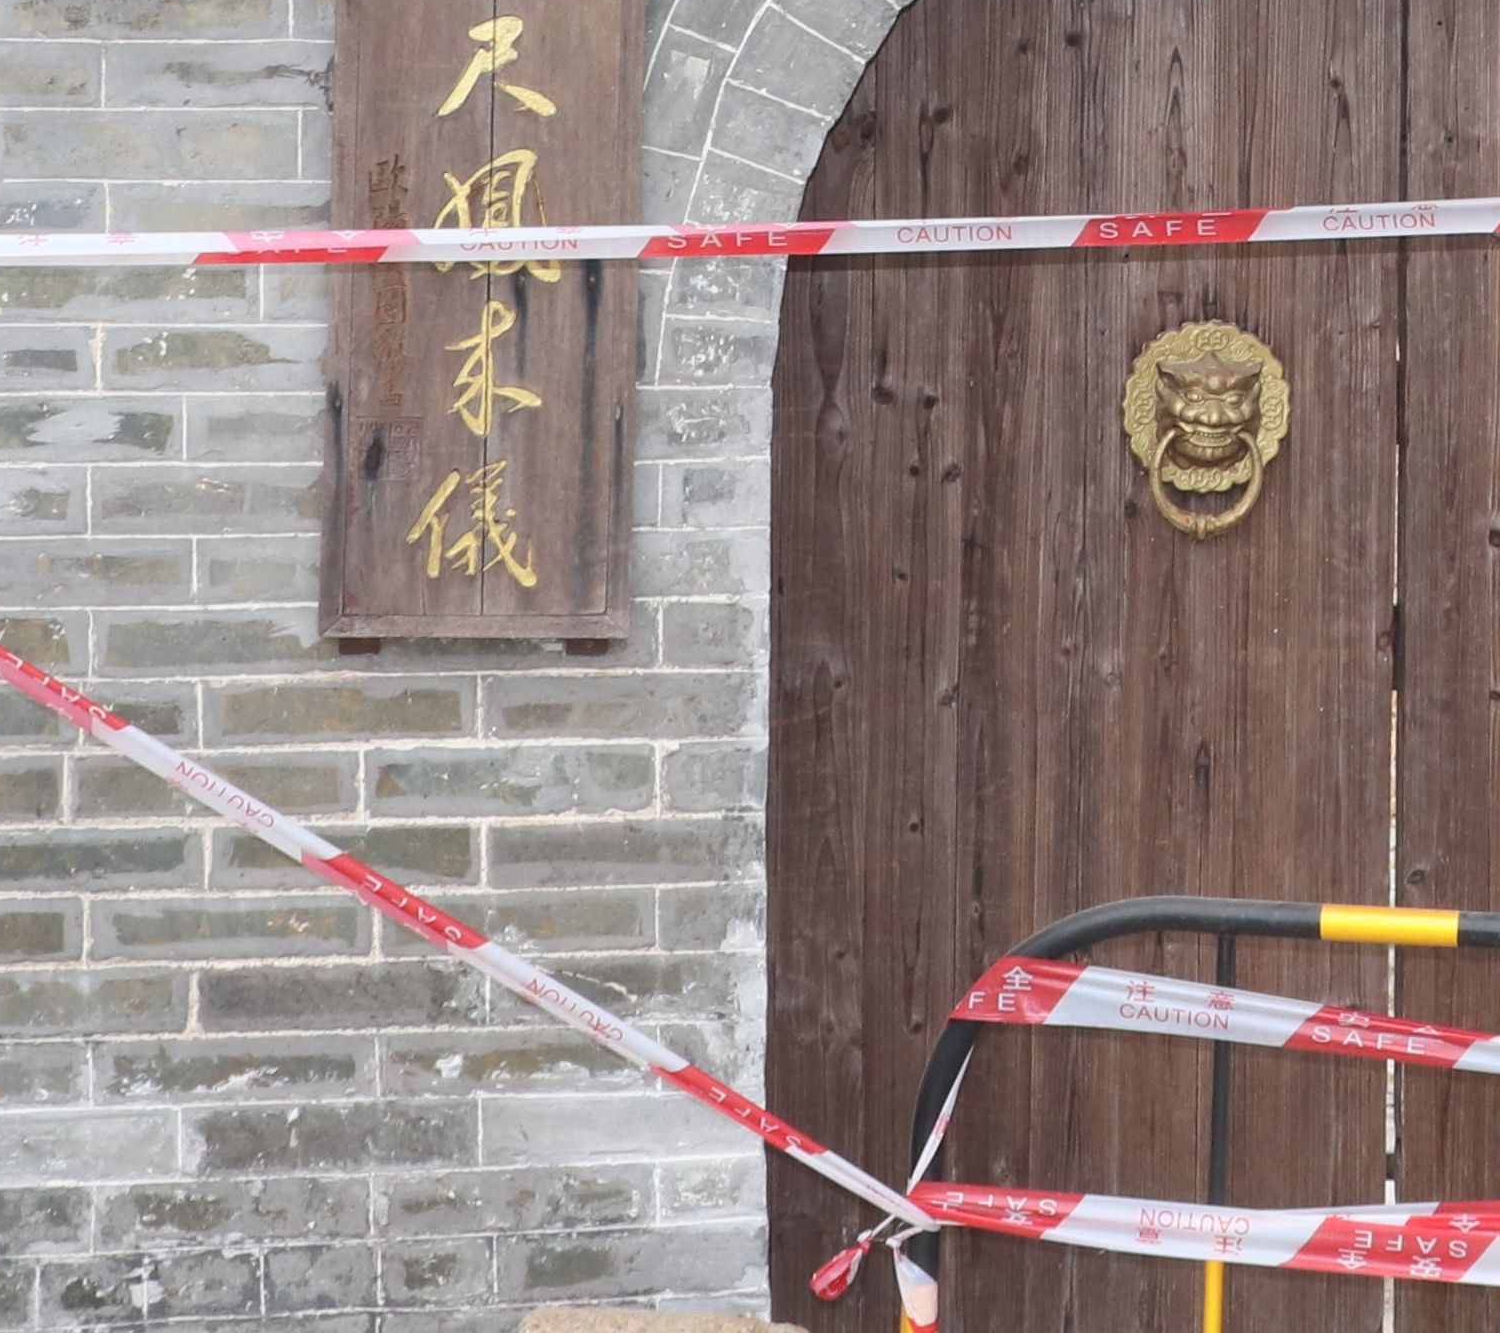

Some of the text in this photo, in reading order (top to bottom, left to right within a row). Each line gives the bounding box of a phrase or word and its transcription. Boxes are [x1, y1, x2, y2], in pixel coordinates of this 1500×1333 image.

[1099, 218, 1217, 239] SAFE
[1322, 211, 1436, 231] CAUTION
[667, 231, 789, 249] SAFE
[896, 225, 1013, 245] CAUTION
[1126, 980, 1236, 1011] 注意
[1119, 1003, 1230, 1030] CAUTION
[1311, 1024, 1428, 1056] SAFE
[1140, 1207, 1250, 1235] CAUTION
[1353, 1229, 1468, 1259] SAFE
